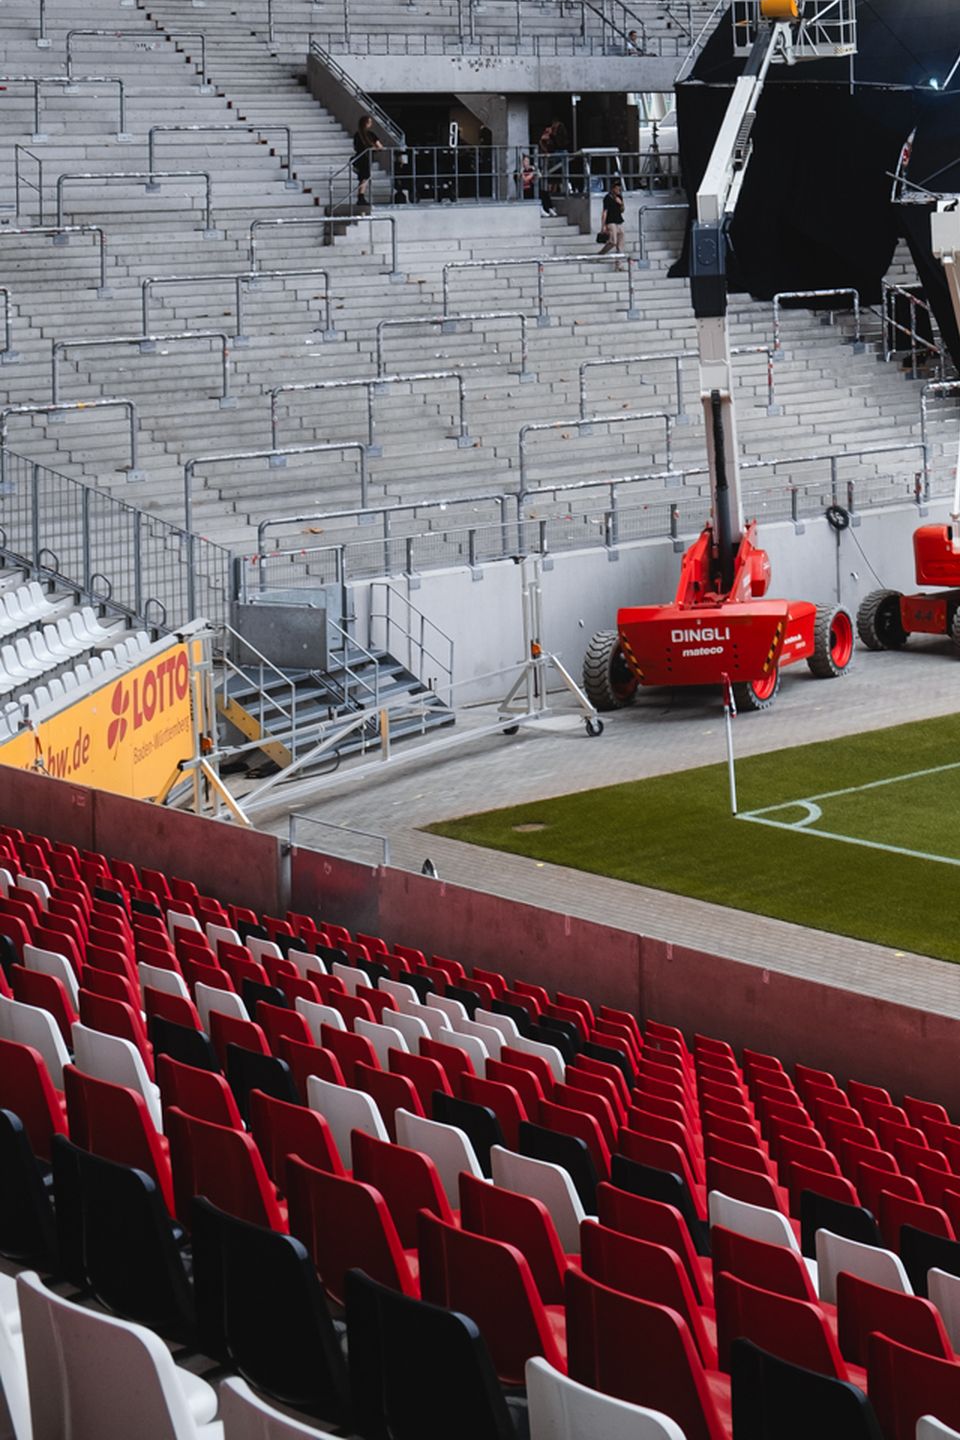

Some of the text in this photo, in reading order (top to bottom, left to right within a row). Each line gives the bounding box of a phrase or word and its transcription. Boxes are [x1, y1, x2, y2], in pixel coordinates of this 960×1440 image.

[671, 627, 730, 643] DINGLI
[682, 646, 724, 657] mateco
[133, 650, 189, 731] LOTTO
